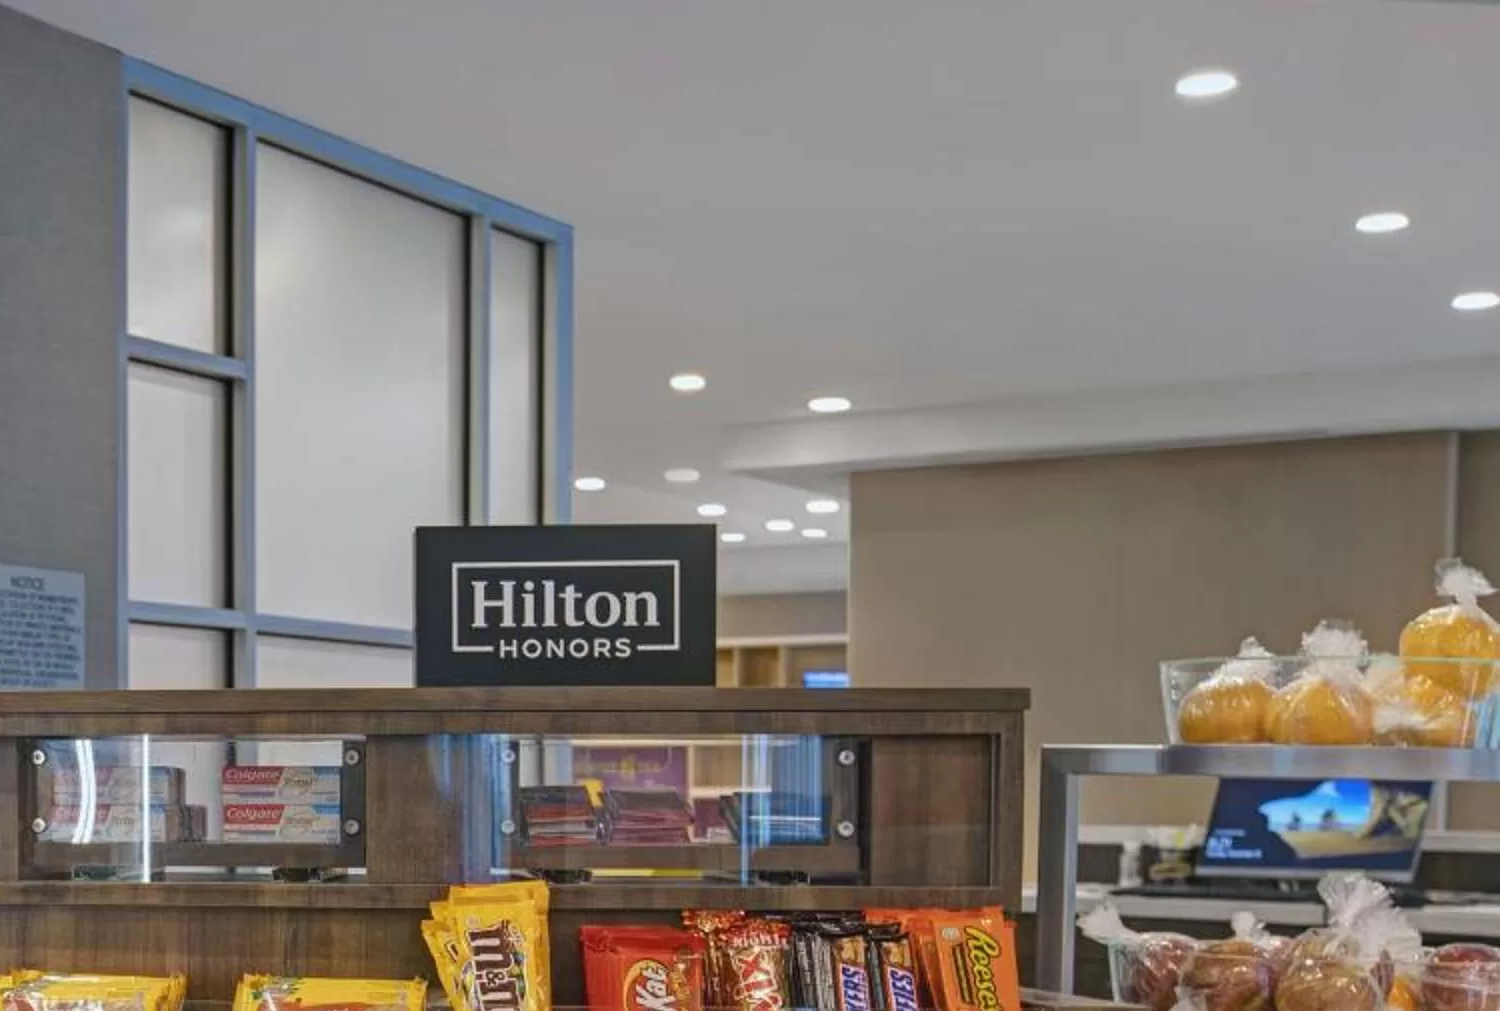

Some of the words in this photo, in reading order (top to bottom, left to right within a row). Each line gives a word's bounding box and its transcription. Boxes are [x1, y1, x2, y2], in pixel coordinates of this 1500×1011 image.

[471, 579, 661, 628] Hilton
[499, 638, 633, 659] HONORS
[227, 768, 281, 785] Colgate
[227, 806, 281, 824] Colgate
